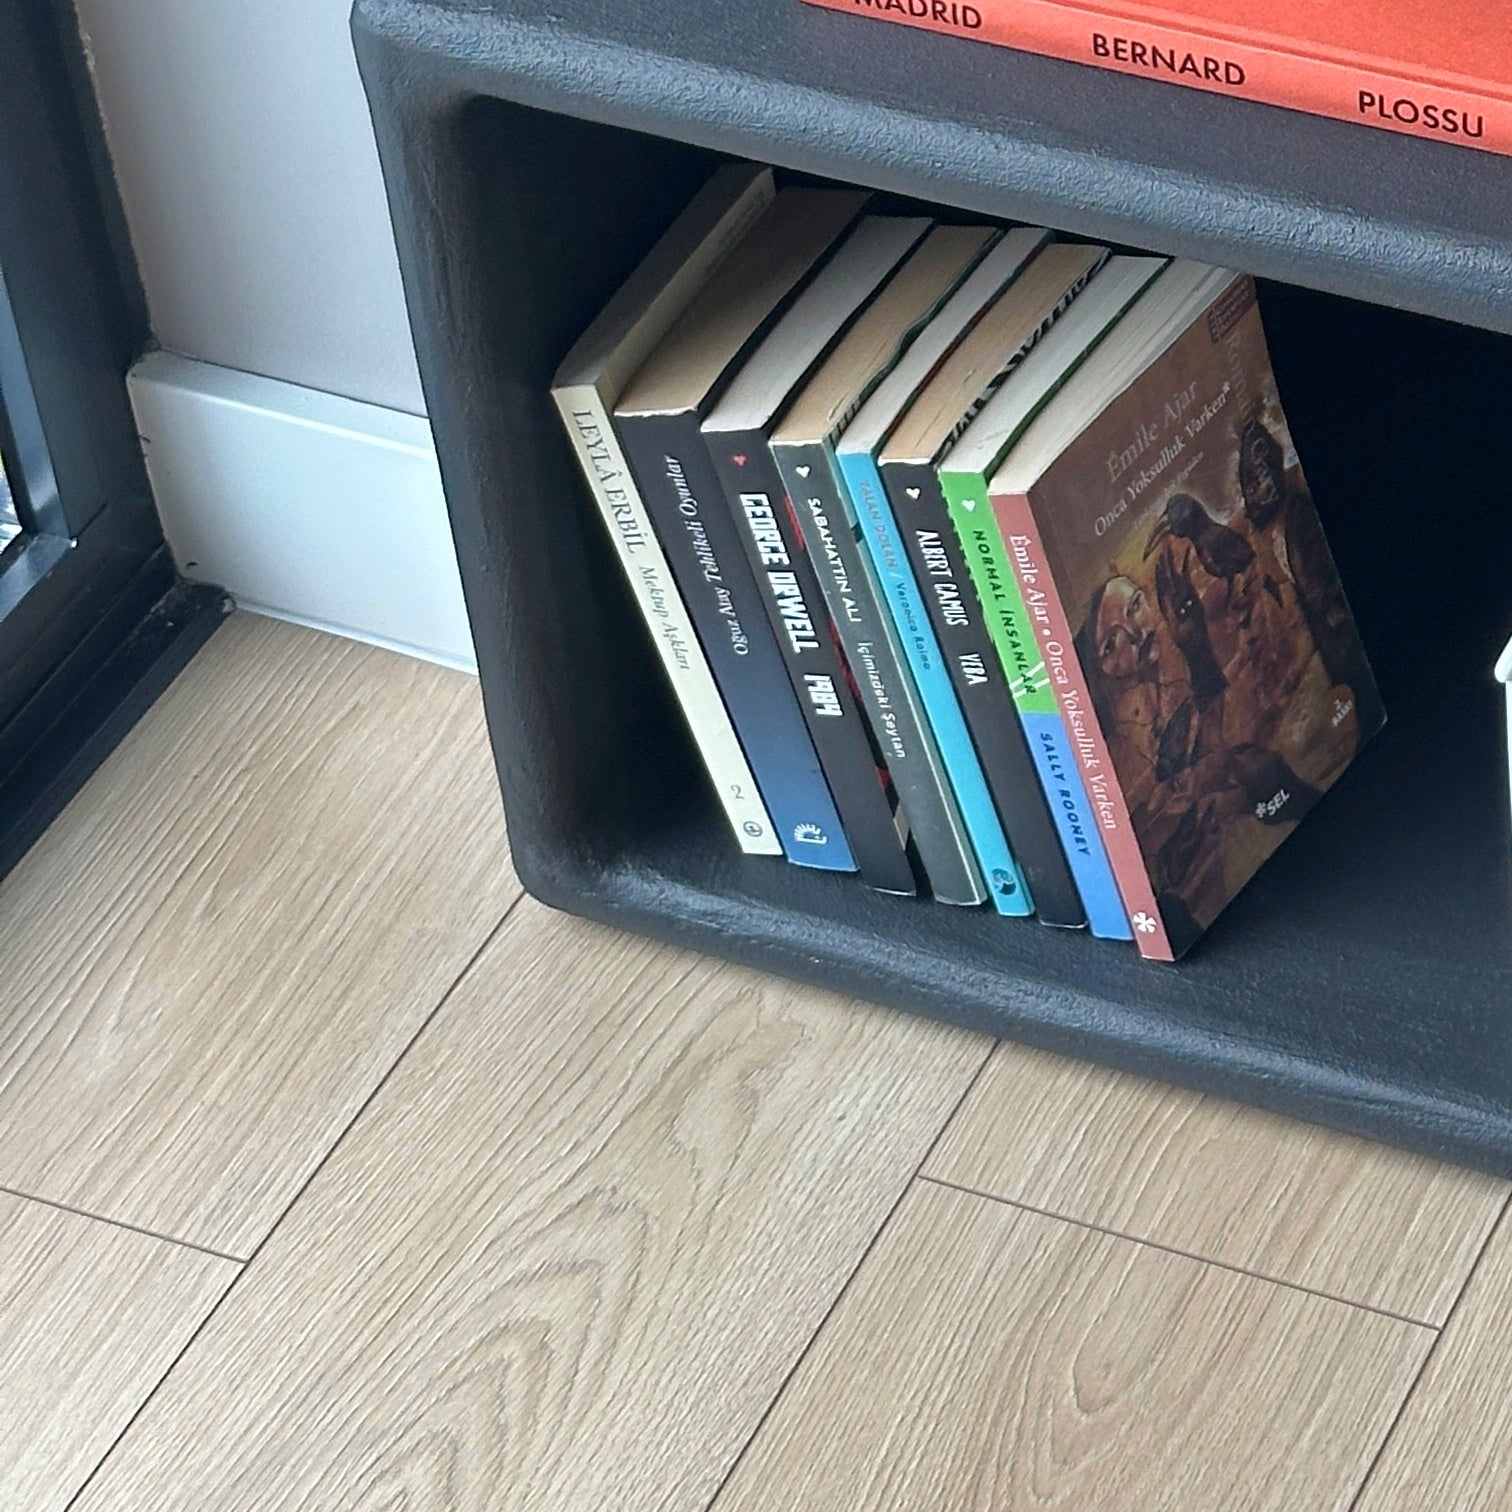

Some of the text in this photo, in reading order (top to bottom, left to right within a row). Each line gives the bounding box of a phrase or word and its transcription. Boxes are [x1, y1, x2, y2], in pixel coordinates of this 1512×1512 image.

[1092, 32, 1246, 86] BERNARD
[1359, 90, 1484, 138] PLOSSU
[1163, 380, 1197, 430] Ajar
[571, 410, 624, 484] LEYLÂ
[604, 486, 649, 554] ERBİL
[664, 454, 699, 517] Oyunlar
[1094, 498, 1128, 537] Onca
[1126, 434, 1186, 500] Yoksulluk
[684, 519, 723, 583] Tehlikeli
[739, 492, 820, 654] GEORGE ORWELL
[915, 529, 970, 627] ALBERT CAMUS
[973, 529, 1006, 601] NORMAL
[803, 673, 844, 717] 1984
[958, 653, 988, 686] VEBA
[1027, 586, 1050, 625] Ajar
[1045, 640, 1069, 685] Onca
[1061, 688, 1101, 770] Yoksulluk
[1089, 774, 1118, 830] Varken
[730, 784, 745, 800] 2
[1041, 732, 1092, 857] SALLY ROONEY
[1266, 788, 1291, 817] SEL
